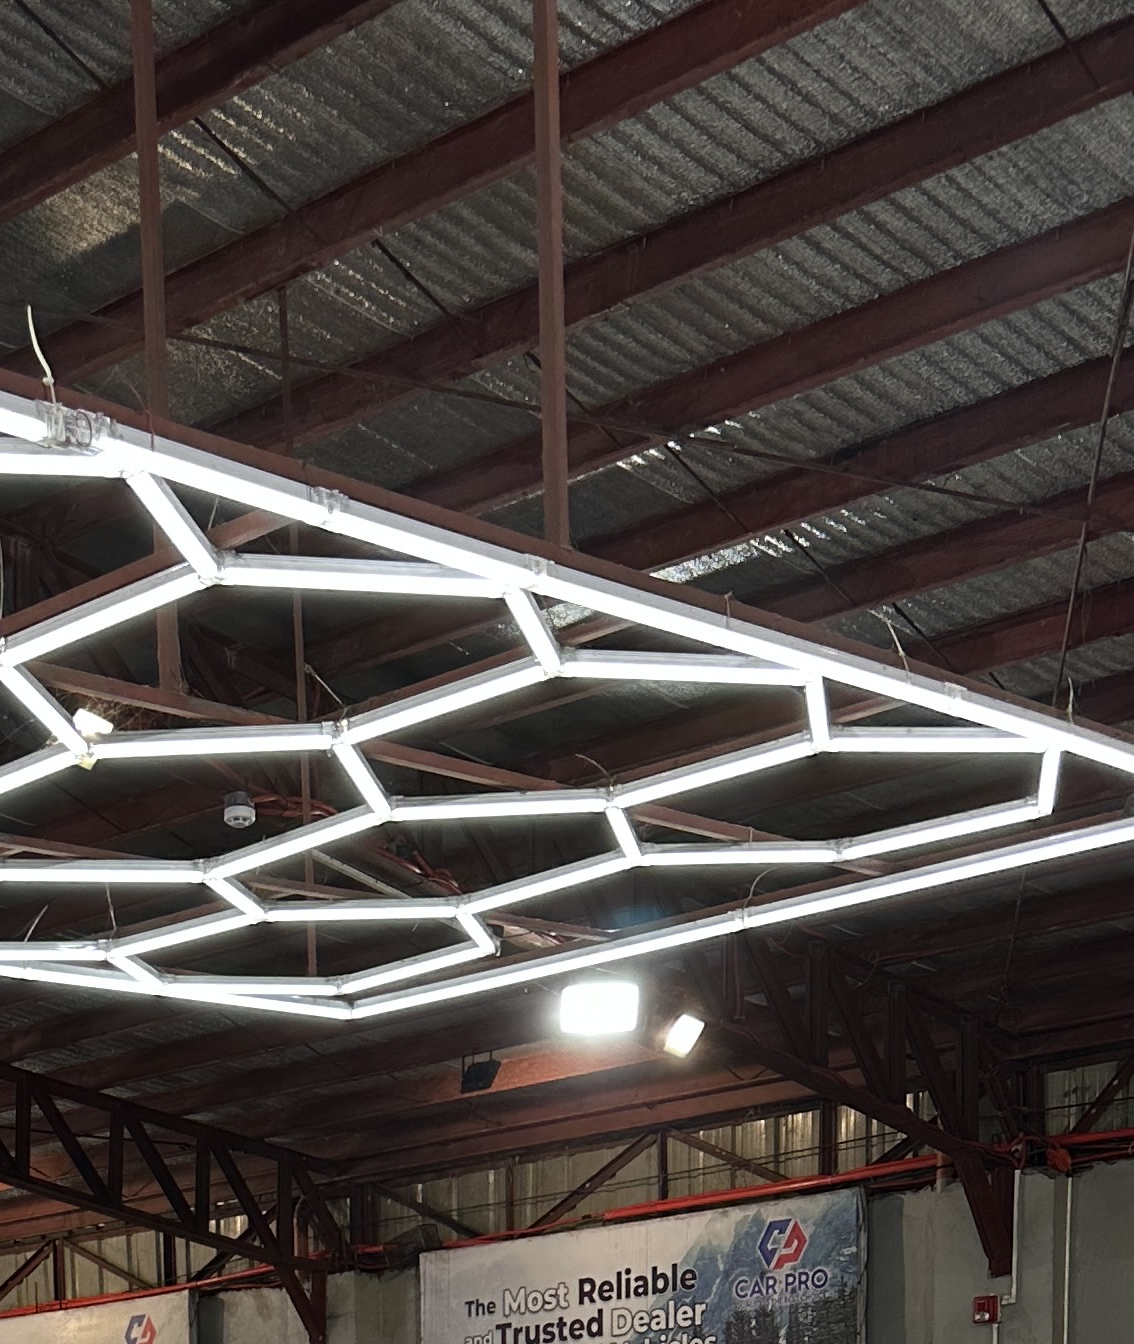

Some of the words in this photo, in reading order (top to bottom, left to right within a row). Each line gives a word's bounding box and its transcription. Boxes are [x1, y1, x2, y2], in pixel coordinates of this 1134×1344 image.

[465, 1299, 496, 1318] The
[502, 1283, 569, 1317] Most
[578, 1263, 697, 1305] Reliable
[734, 1275, 777, 1298] CAR
[785, 1268, 828, 1293] PRO
[610, 1302, 706, 1337] Dealer
